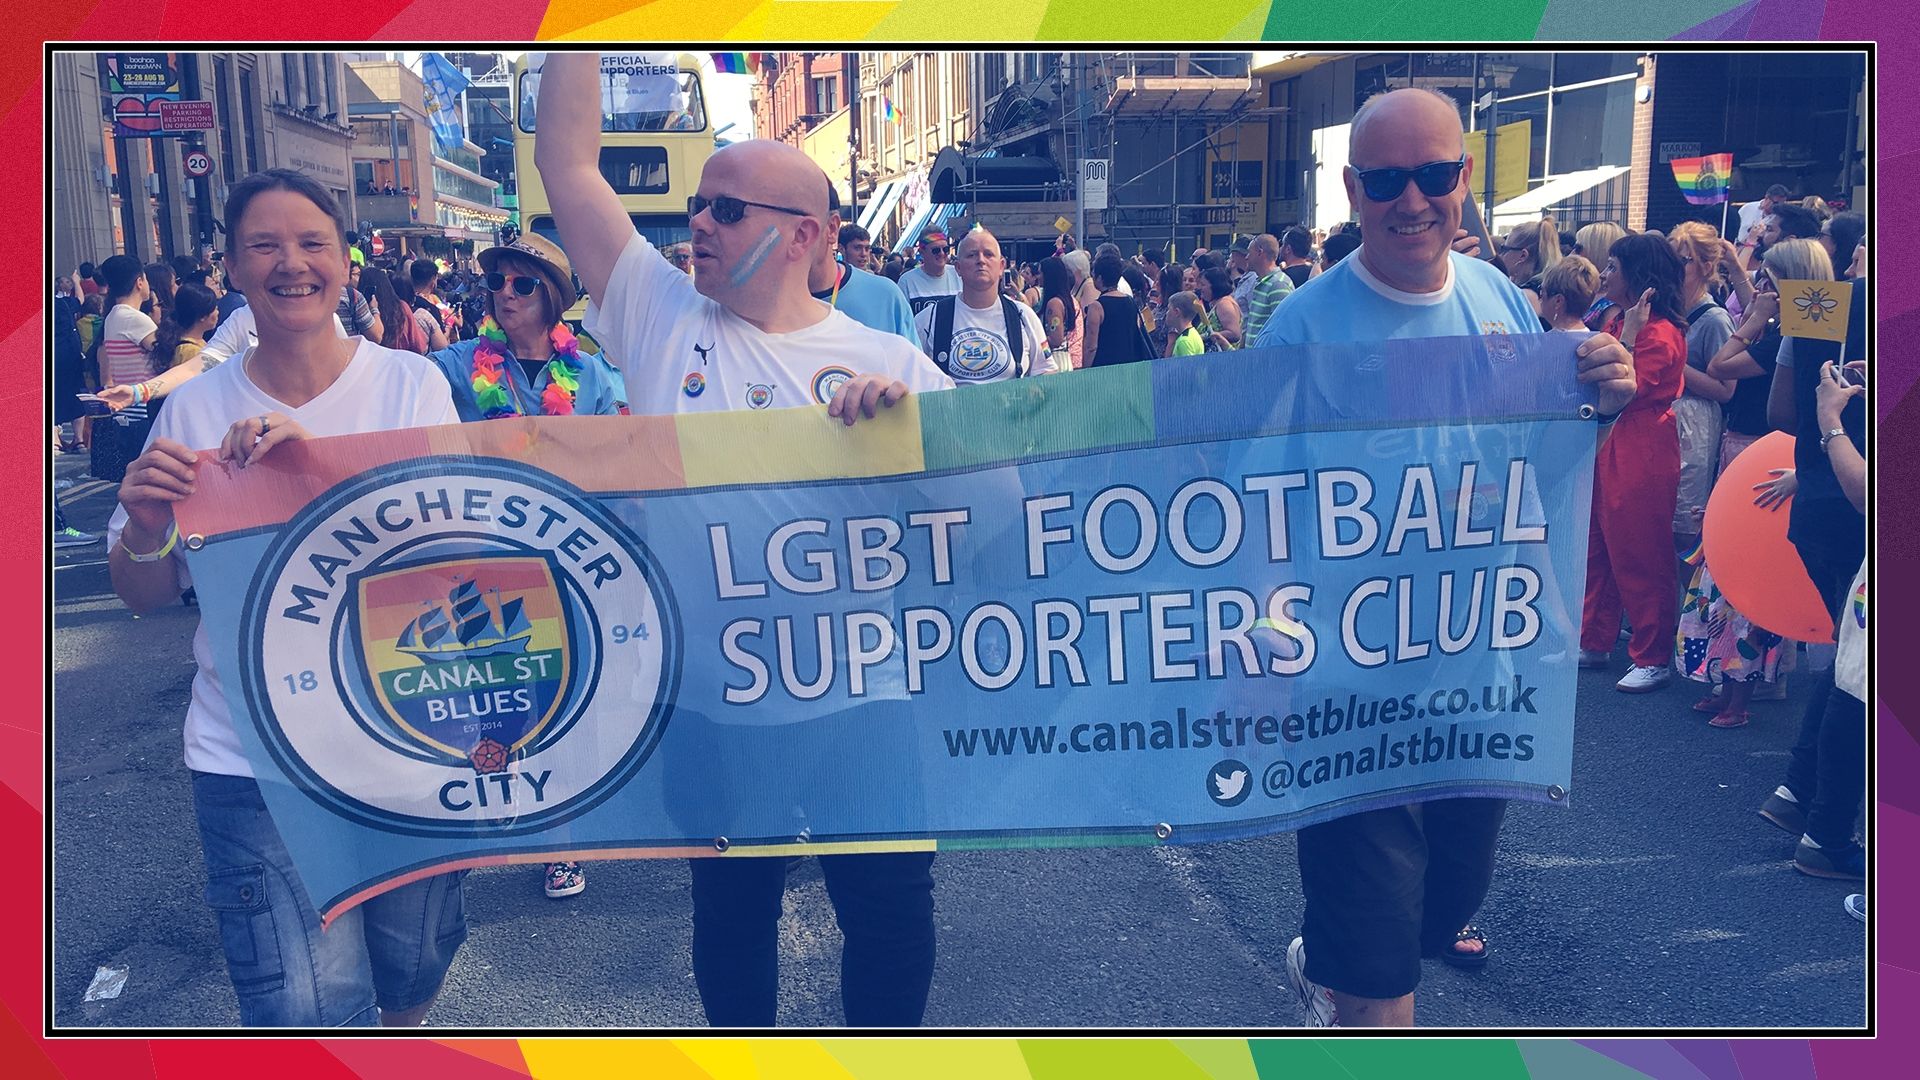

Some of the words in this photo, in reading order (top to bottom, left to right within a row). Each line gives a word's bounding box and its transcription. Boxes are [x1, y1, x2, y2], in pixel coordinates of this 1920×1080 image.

[600, 65, 676, 76] UPPORTERS
[601, 56, 651, 66] FFICIAL
[189, 158, 207, 169] 20
[706, 507, 972, 601] LGBT
[1022, 457, 1549, 580] FOOTBALL
[282, 487, 623, 625] MANCHESTER
[611, 623, 651, 645] 94
[719, 581, 1318, 706] SUPPORTERS
[1340, 563, 1544, 669] CLUB
[282, 669, 319, 695] 18
[393, 658, 505, 698] CANAL
[514, 653, 553, 681] ST
[426, 688, 532, 723] BLUES
[943, 674, 1539, 757] www.canalstreetblues.co.uk
[463, 722, 479, 733] EST
[481, 720, 503, 731] 2014
[1261, 728, 1535, 799] @canalstblues
[438, 768, 553, 812] CITY
